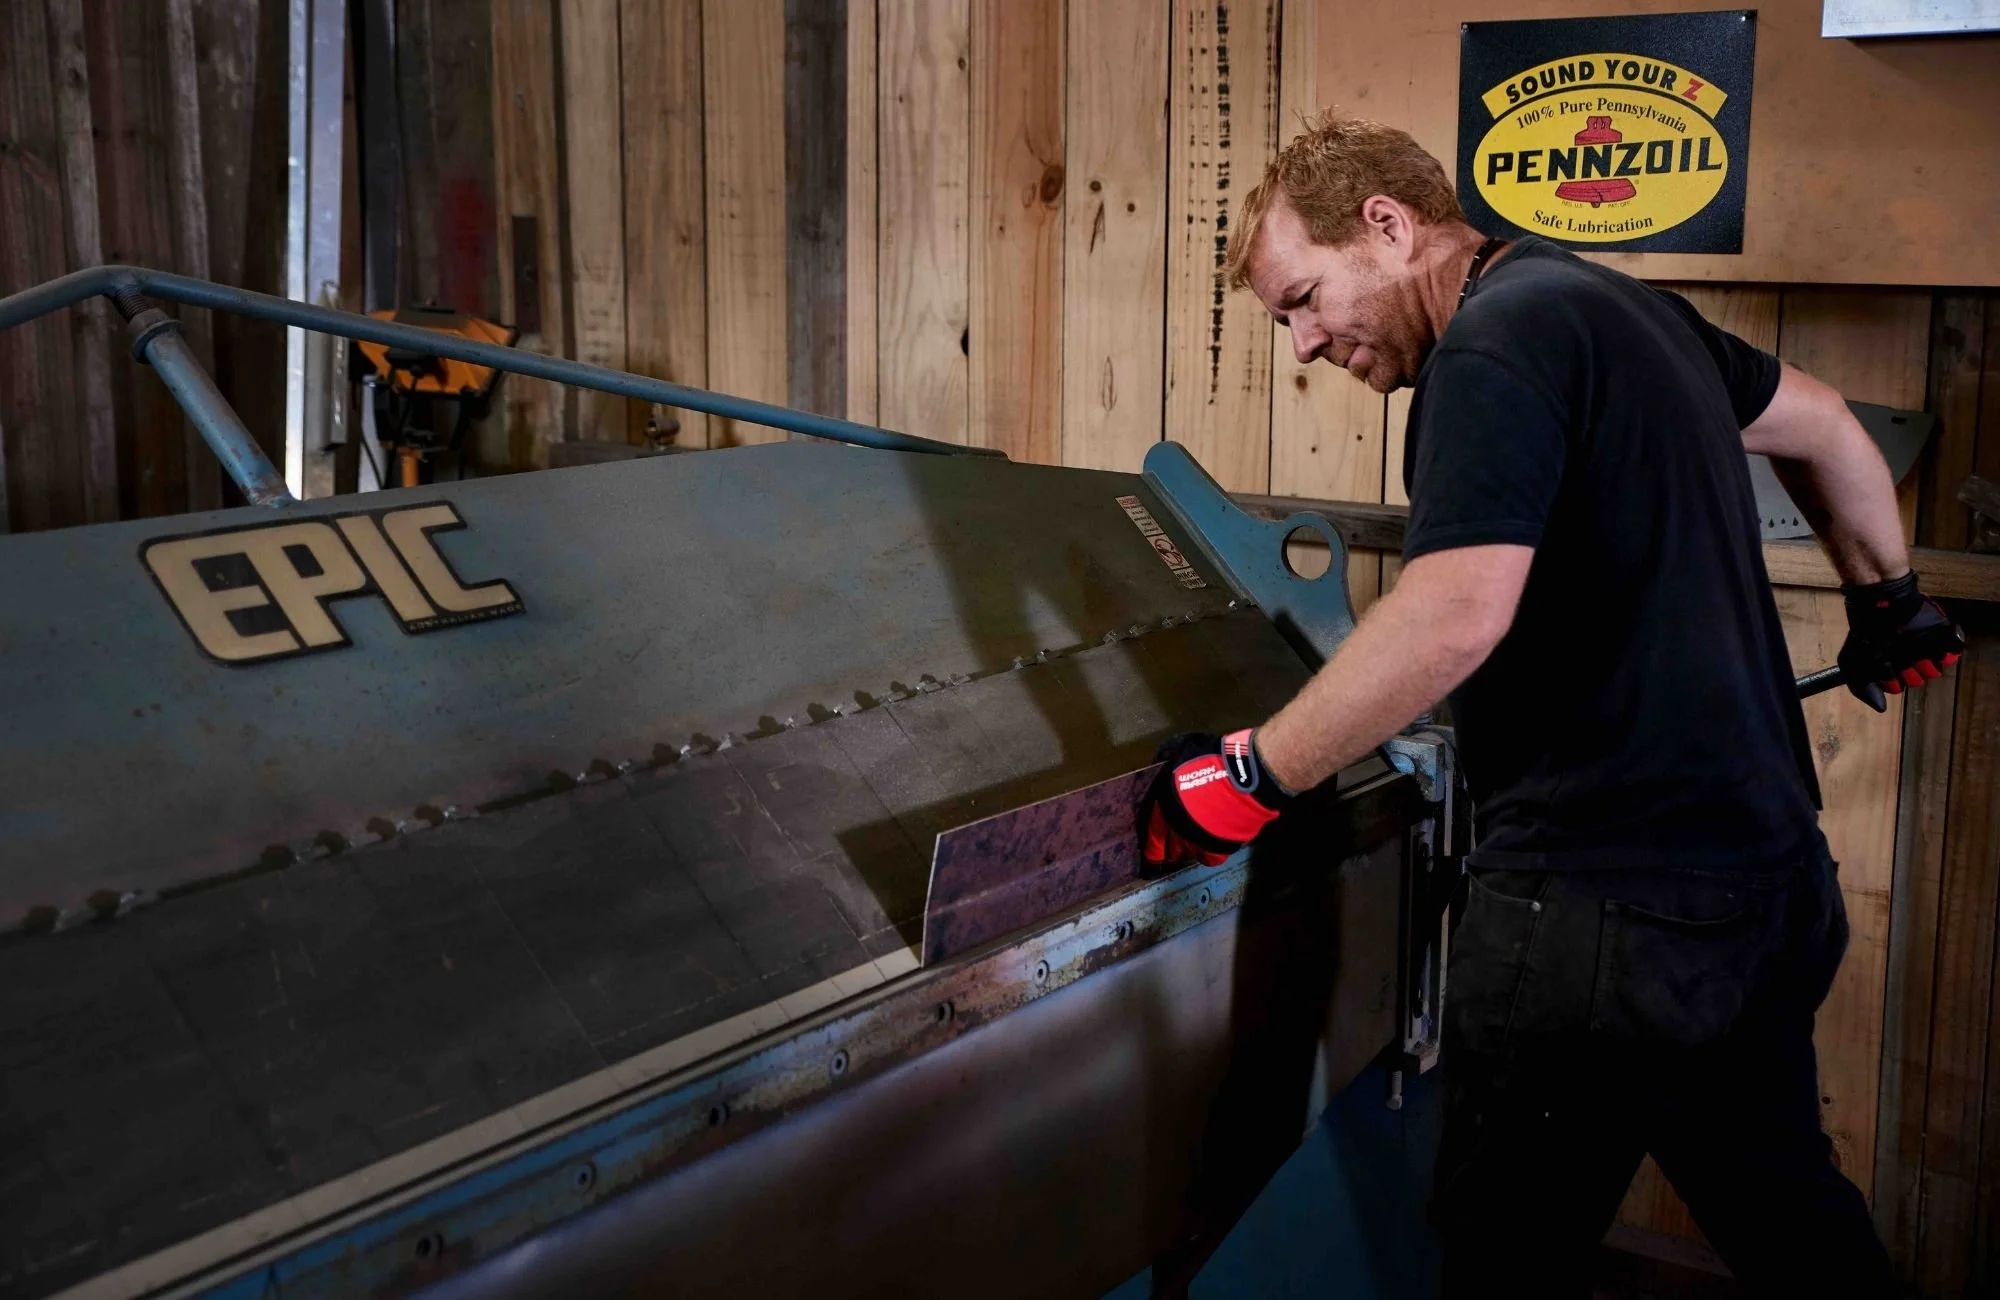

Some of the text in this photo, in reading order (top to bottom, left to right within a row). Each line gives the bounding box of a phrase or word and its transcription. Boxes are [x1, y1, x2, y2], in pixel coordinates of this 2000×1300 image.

[1506, 59, 1705, 103] SOUND YOUR Z
[1516, 97, 1688, 133] 100% Pure Pennsylvania
[1486, 136, 1723, 186] PENNZOIL
[1532, 209, 1654, 234] Safe Lubrication
[143, 503, 520, 662] EPIC
[1179, 766, 1215, 781] WORK
